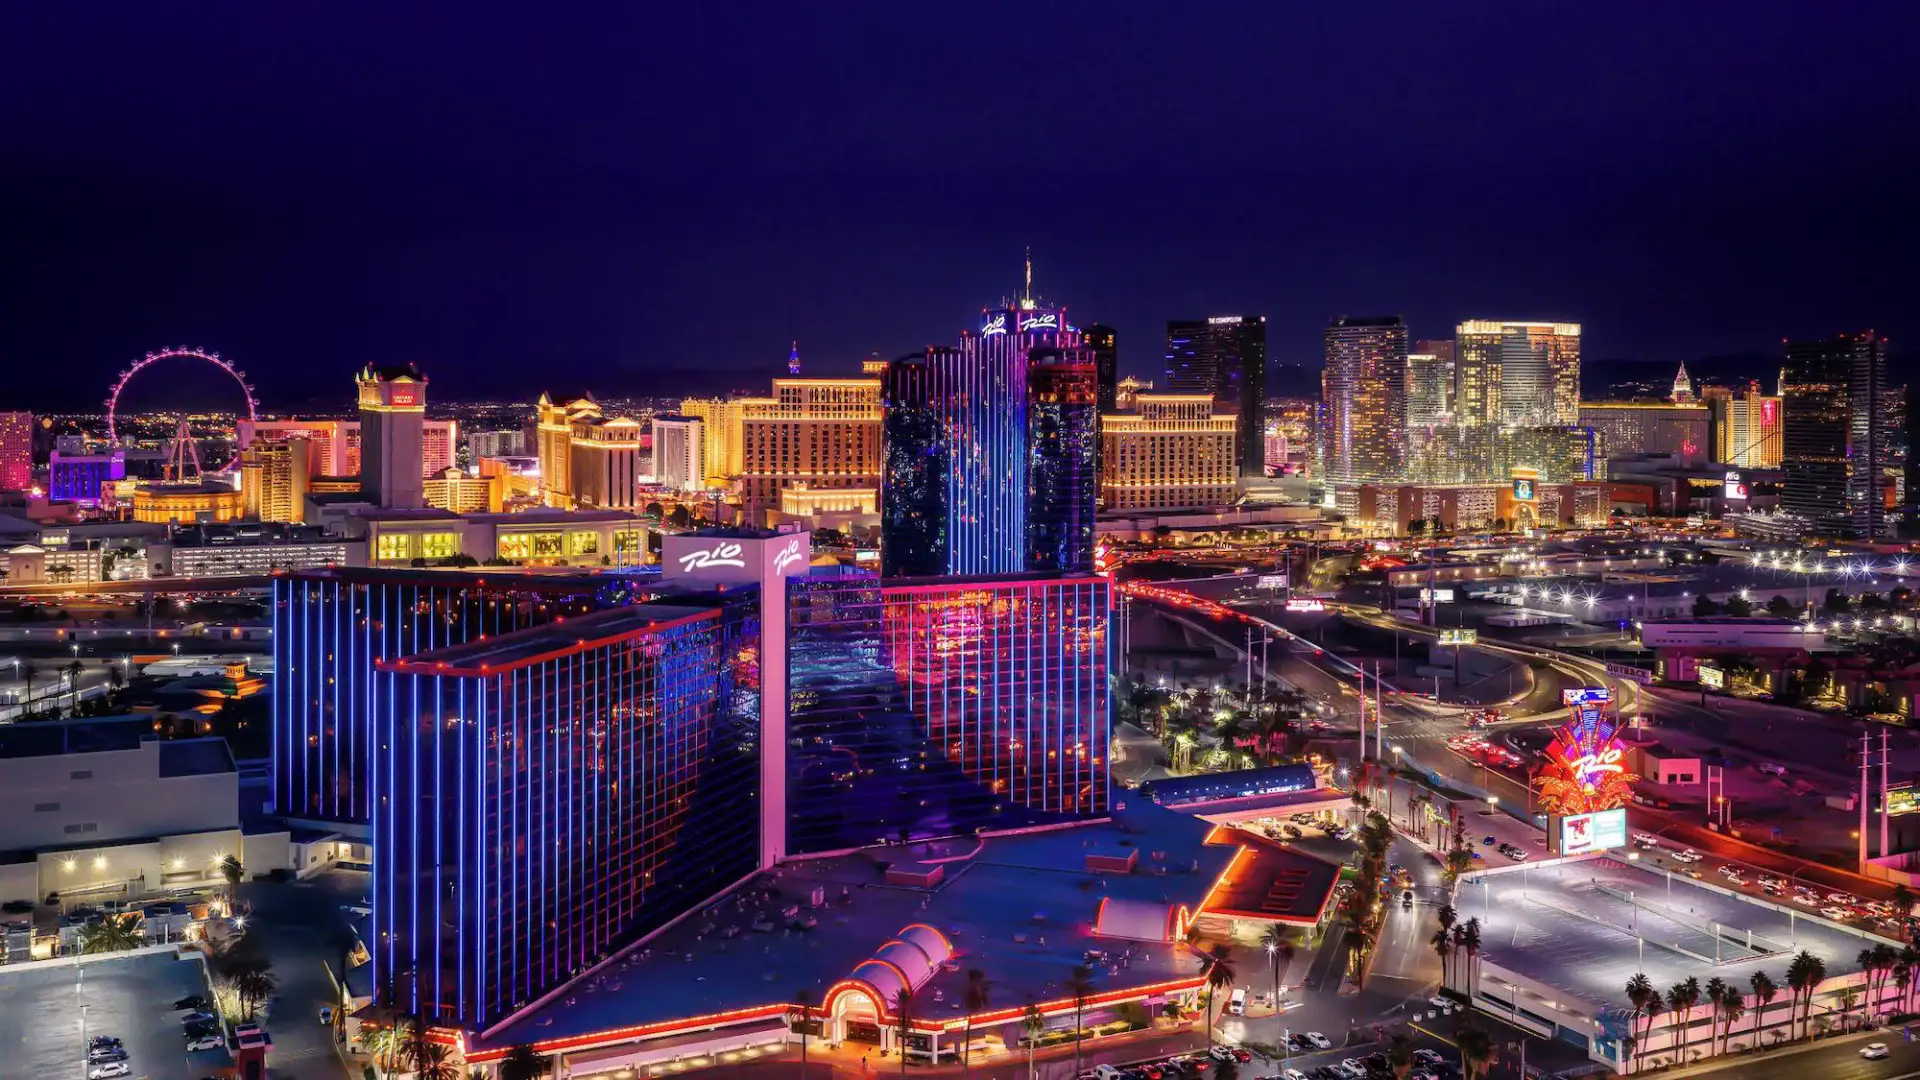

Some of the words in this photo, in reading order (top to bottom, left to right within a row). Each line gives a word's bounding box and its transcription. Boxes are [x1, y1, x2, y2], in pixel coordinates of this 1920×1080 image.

[982, 313, 1006, 338] Rio
[1020, 313, 1057, 331] Rio
[679, 541, 745, 572] Rio
[774, 539, 802, 576] Rio
[1607, 663, 1647, 677] OUTBACK
[1570, 744, 1623, 780] Rio
